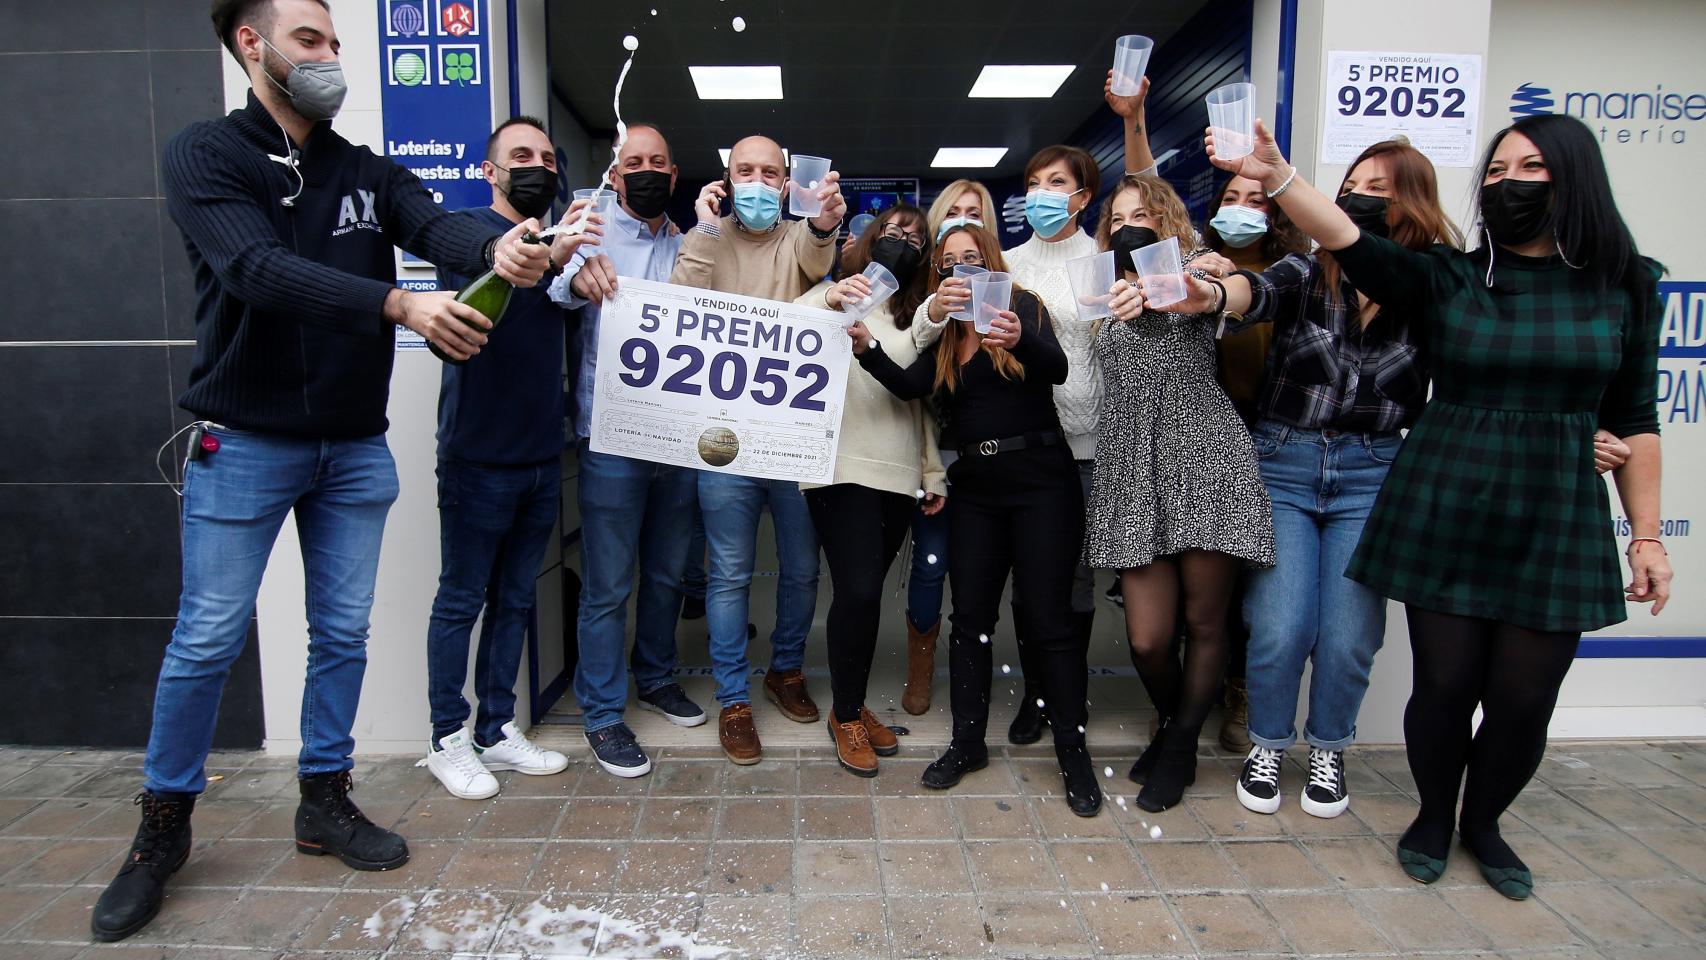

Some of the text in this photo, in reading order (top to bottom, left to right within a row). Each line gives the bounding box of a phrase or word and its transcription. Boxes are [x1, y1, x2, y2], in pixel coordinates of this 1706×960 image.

[1369, 65, 1459, 84] PREMIO
[1337, 85, 1466, 118] 92052
[1565, 84, 1706, 120] manise
[388, 139, 465, 159] Loterías y
[409, 163, 487, 180] uestas de
[402, 282, 437, 290] AFORO
[694, 297, 780, 319] VENDIDO AQUÍ
[675, 309, 823, 357] PREMIO
[618, 337, 830, 412] 92052
[652, 434, 682, 443] NAVIDAD
[771, 451, 802, 459] DICIEMBRE
